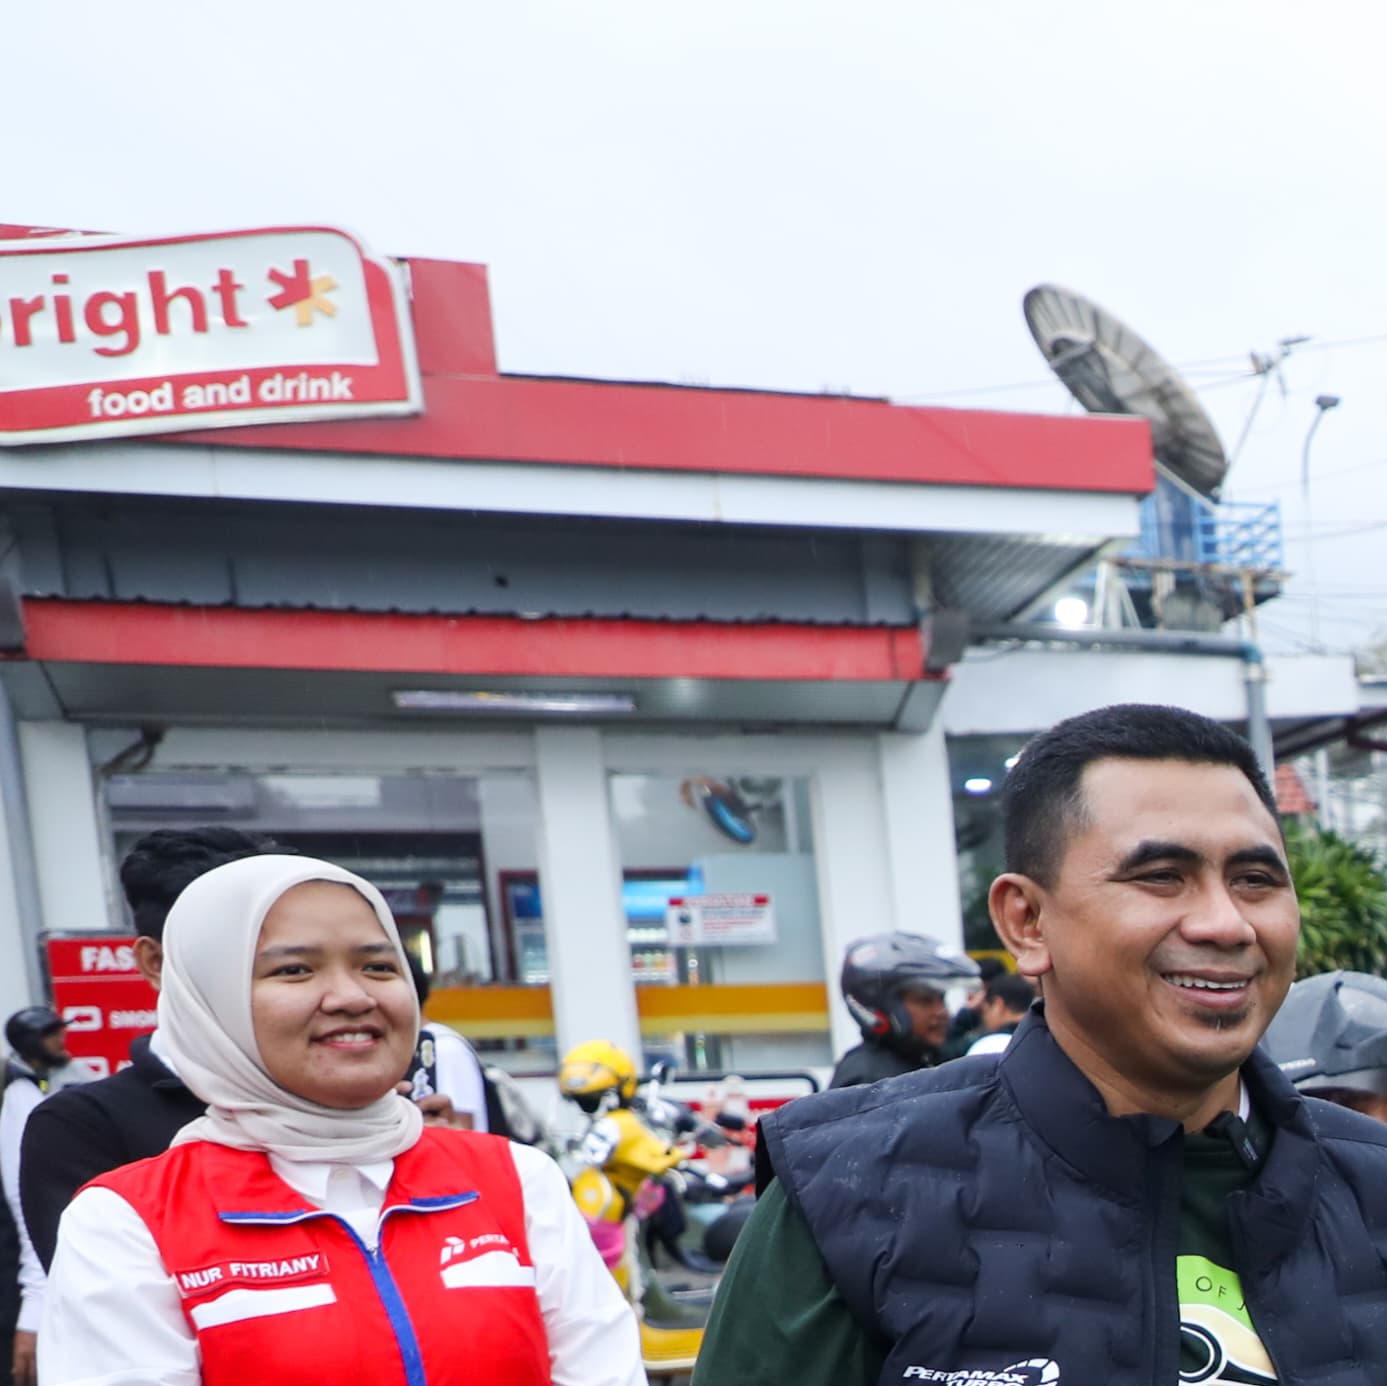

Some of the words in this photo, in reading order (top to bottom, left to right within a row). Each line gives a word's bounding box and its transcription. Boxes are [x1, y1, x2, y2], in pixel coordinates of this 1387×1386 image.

[0, 267, 249, 357] right
[88, 387, 175, 418] food
[182, 374, 252, 410] and
[258, 370, 354, 404] drink
[180, 1266, 224, 1291] NUR
[229, 1253, 321, 1279] FITRIANY
[1194, 1275, 1228, 1299] OF
[902, 1365, 1030, 1385] PERTAMAX
